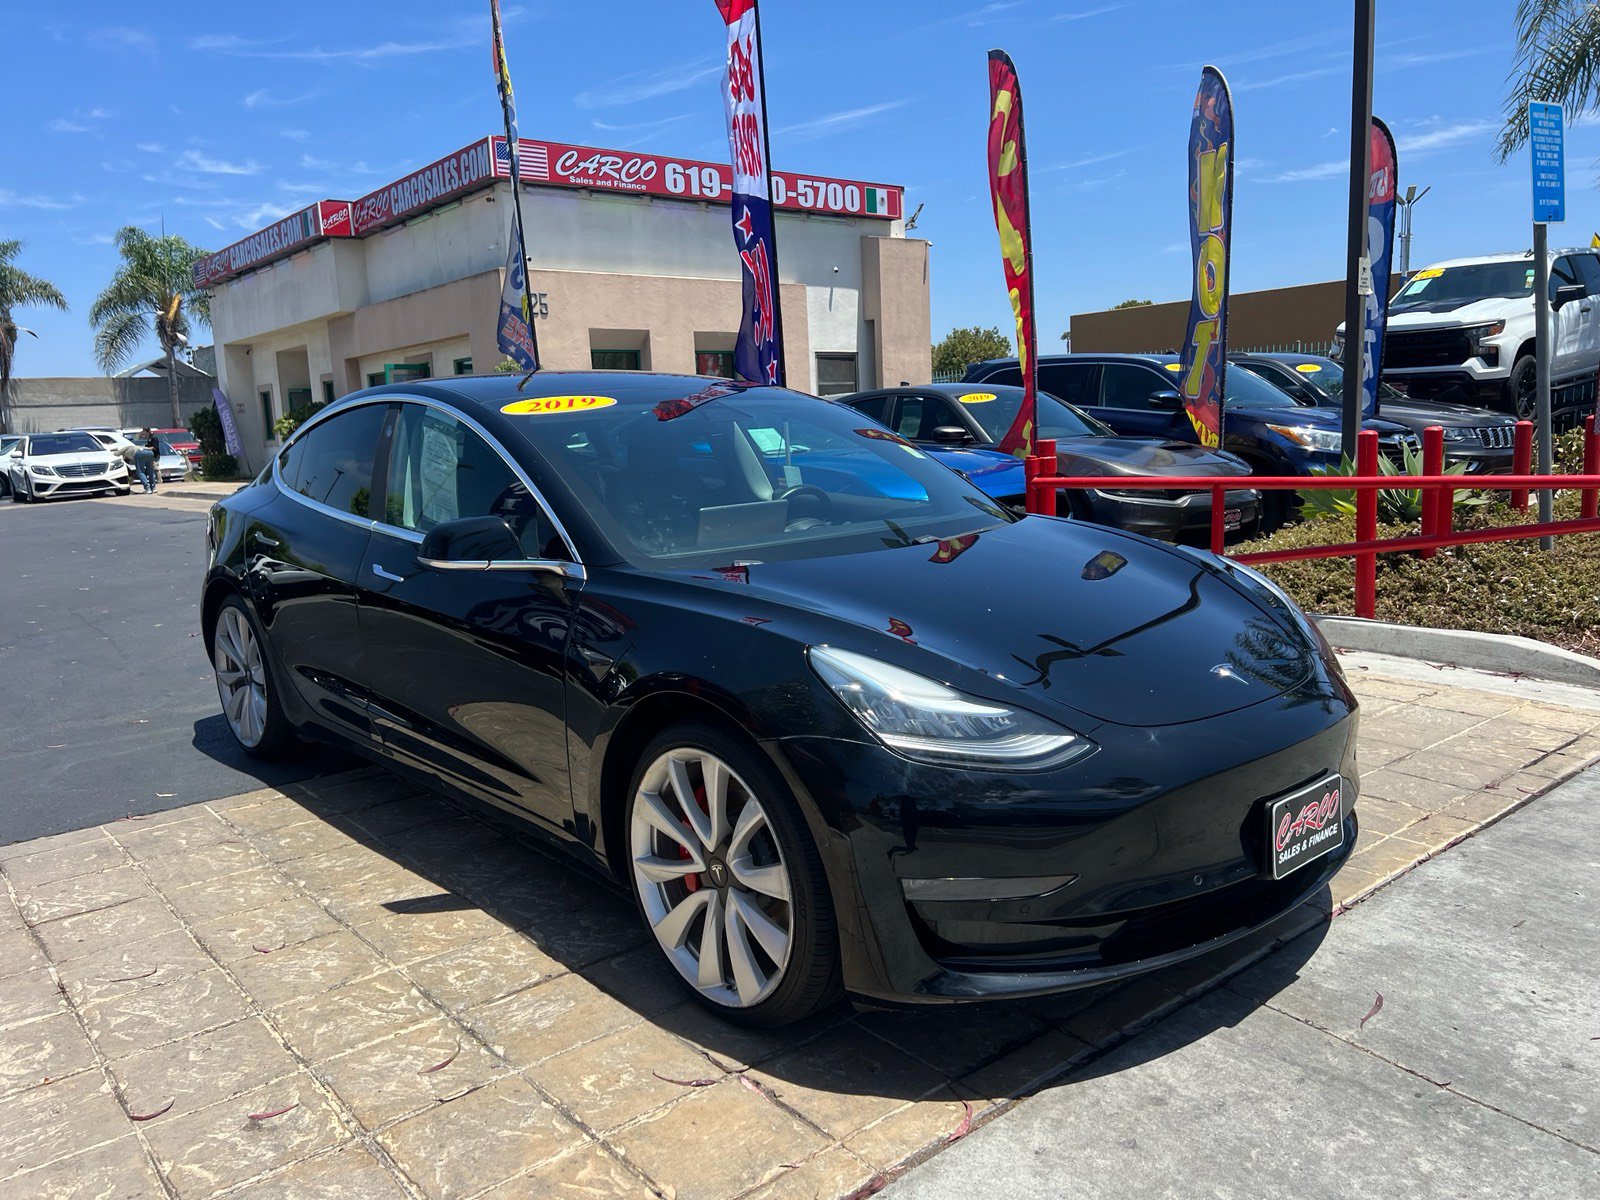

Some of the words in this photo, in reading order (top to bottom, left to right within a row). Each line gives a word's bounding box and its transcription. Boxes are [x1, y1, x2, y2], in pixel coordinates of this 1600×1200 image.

[353, 190, 390, 228] CARCO
[391, 142, 490, 216] CARCOSALES.COM
[554, 150, 658, 183] CARCO
[664, 162, 861, 214] 619-0-5700
[569, 175, 595, 186] Sales
[596, 178, 612, 187] and
[613, 180, 647, 191] Finance
[322, 208, 348, 229] CARCO
[230, 218, 303, 271] CARCOSALES.COM
[527, 397, 597, 412] 2019
[1276, 789, 1339, 852] CARCO
[1278, 842, 1301, 865] SALES
[1301, 838, 1308, 852] &
[1308, 822, 1338, 850] FINANCE
